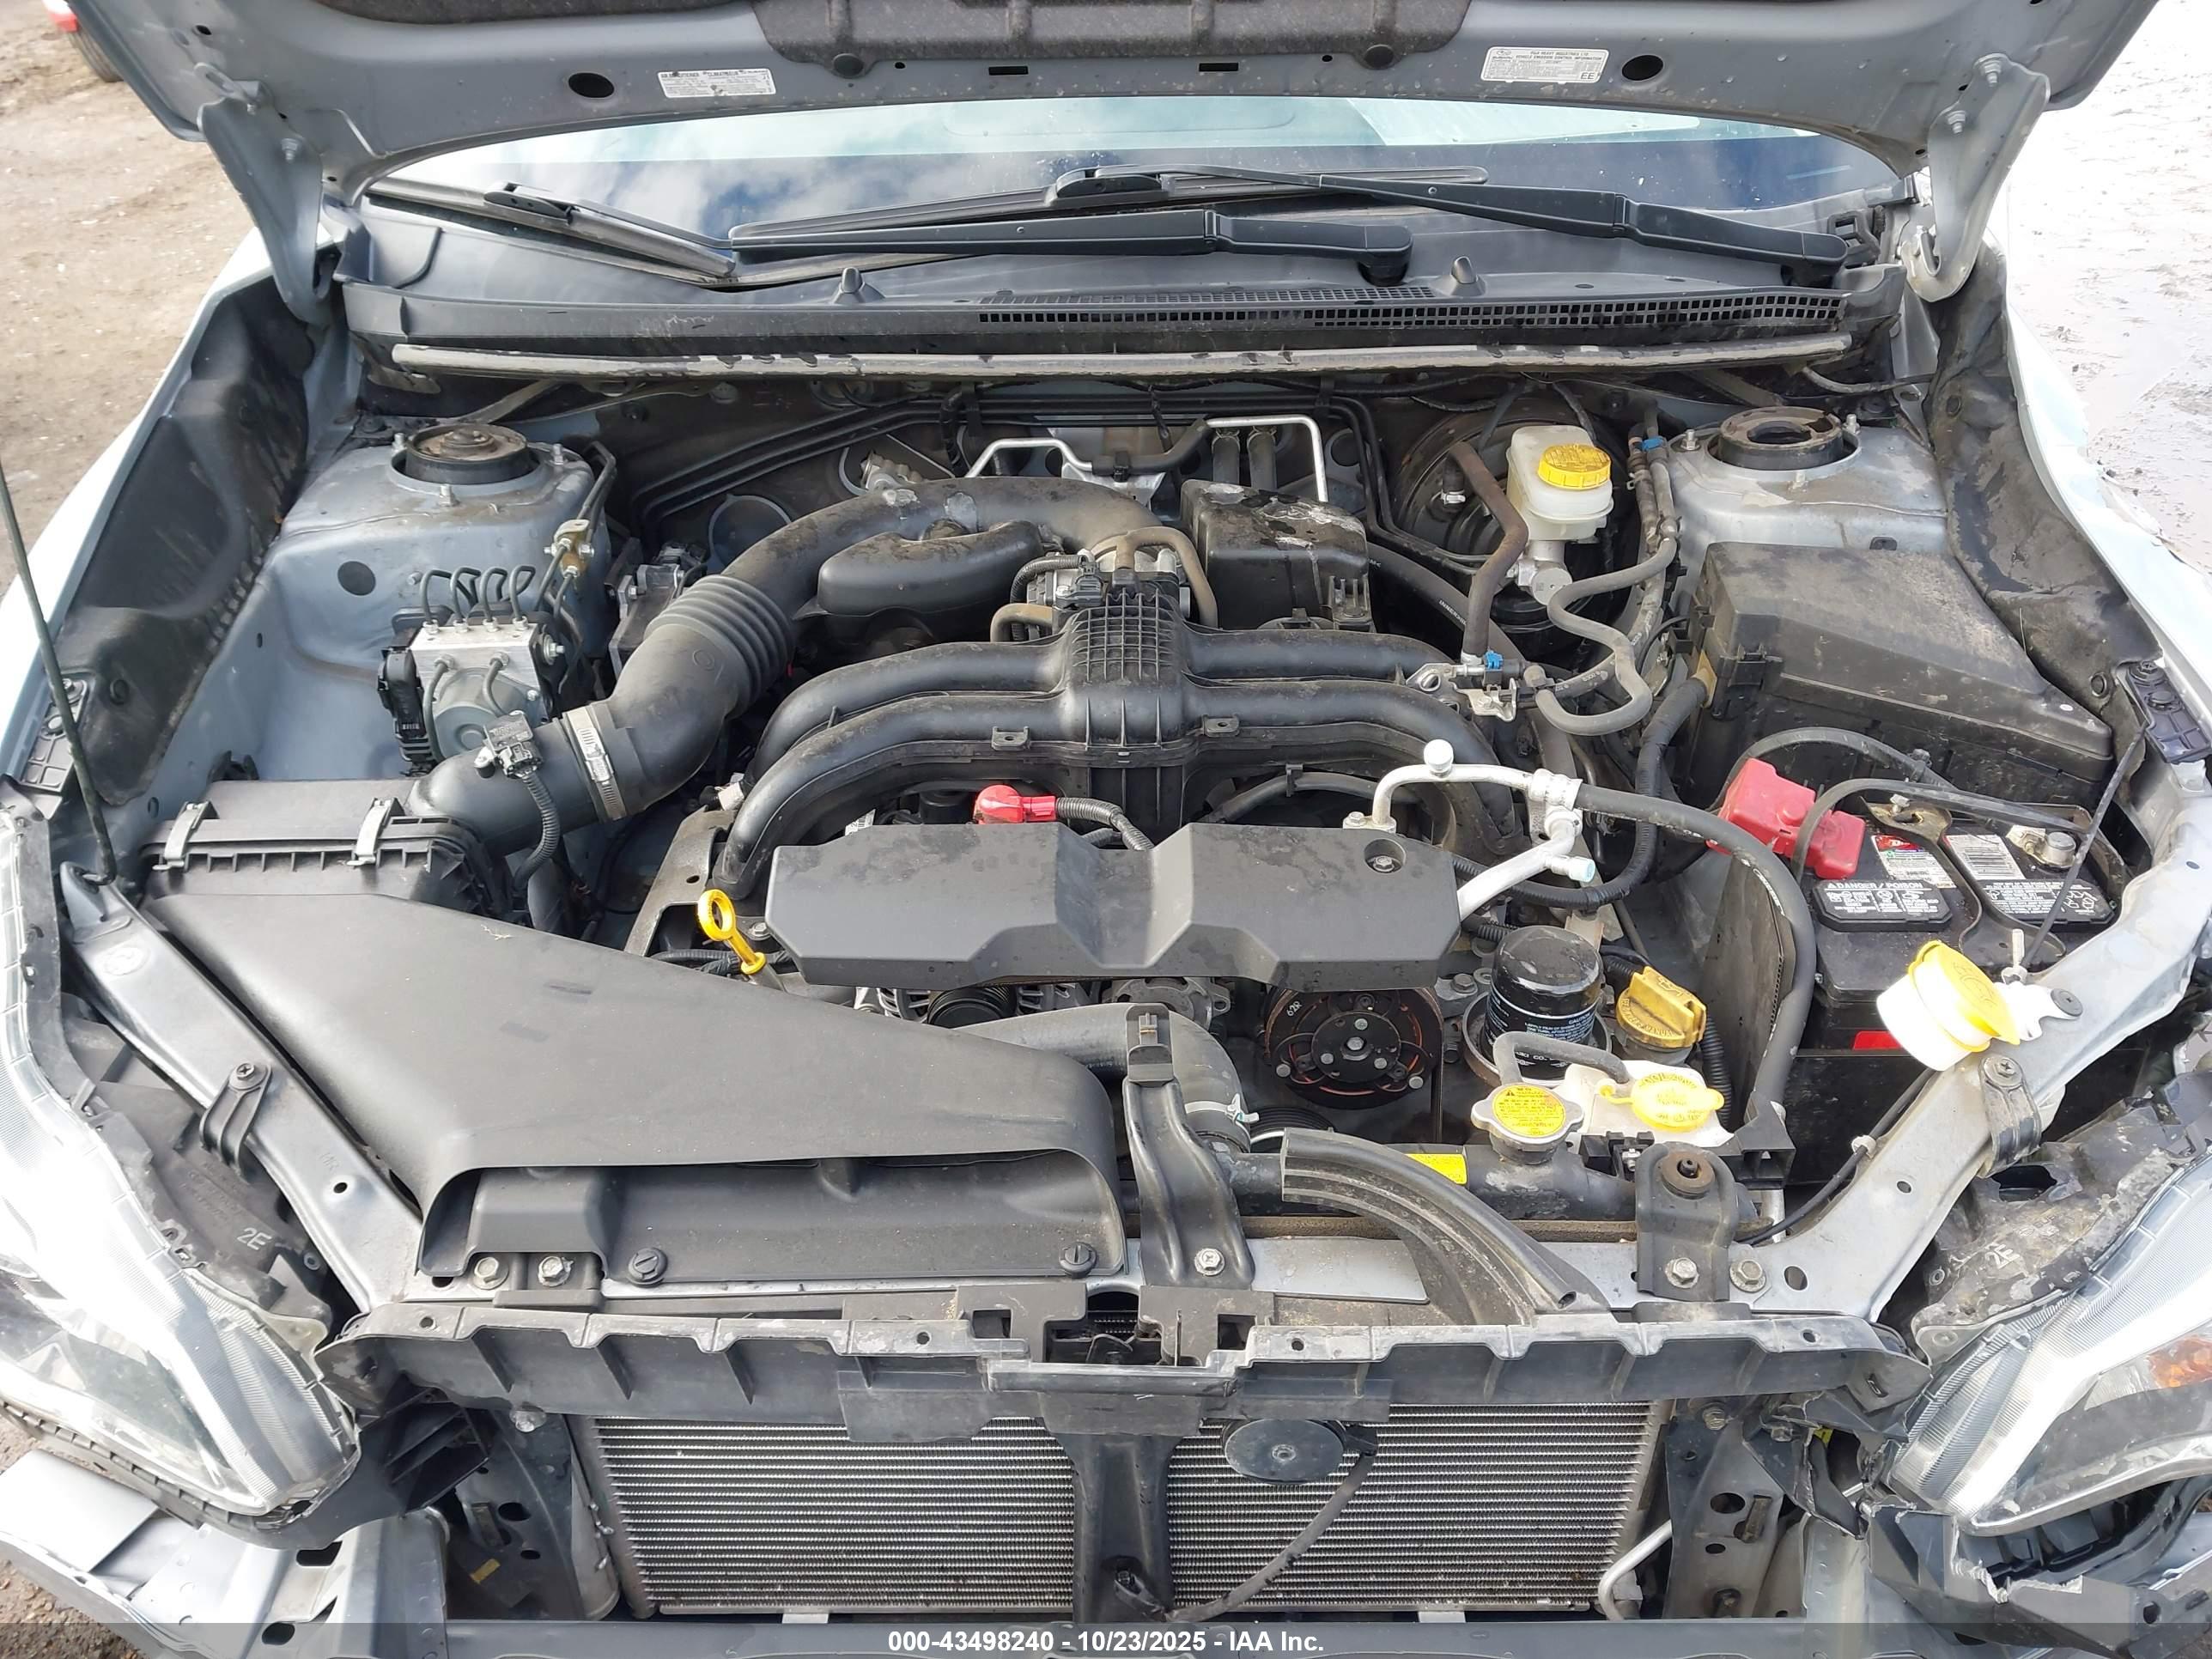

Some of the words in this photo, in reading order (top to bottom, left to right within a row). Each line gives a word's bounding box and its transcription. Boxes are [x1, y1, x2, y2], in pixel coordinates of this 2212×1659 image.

[1286, 1000, 1303, 1017] 62R
[237, 1227, 272, 1250] 2E
[1985, 1242, 2021, 1269] 2E
